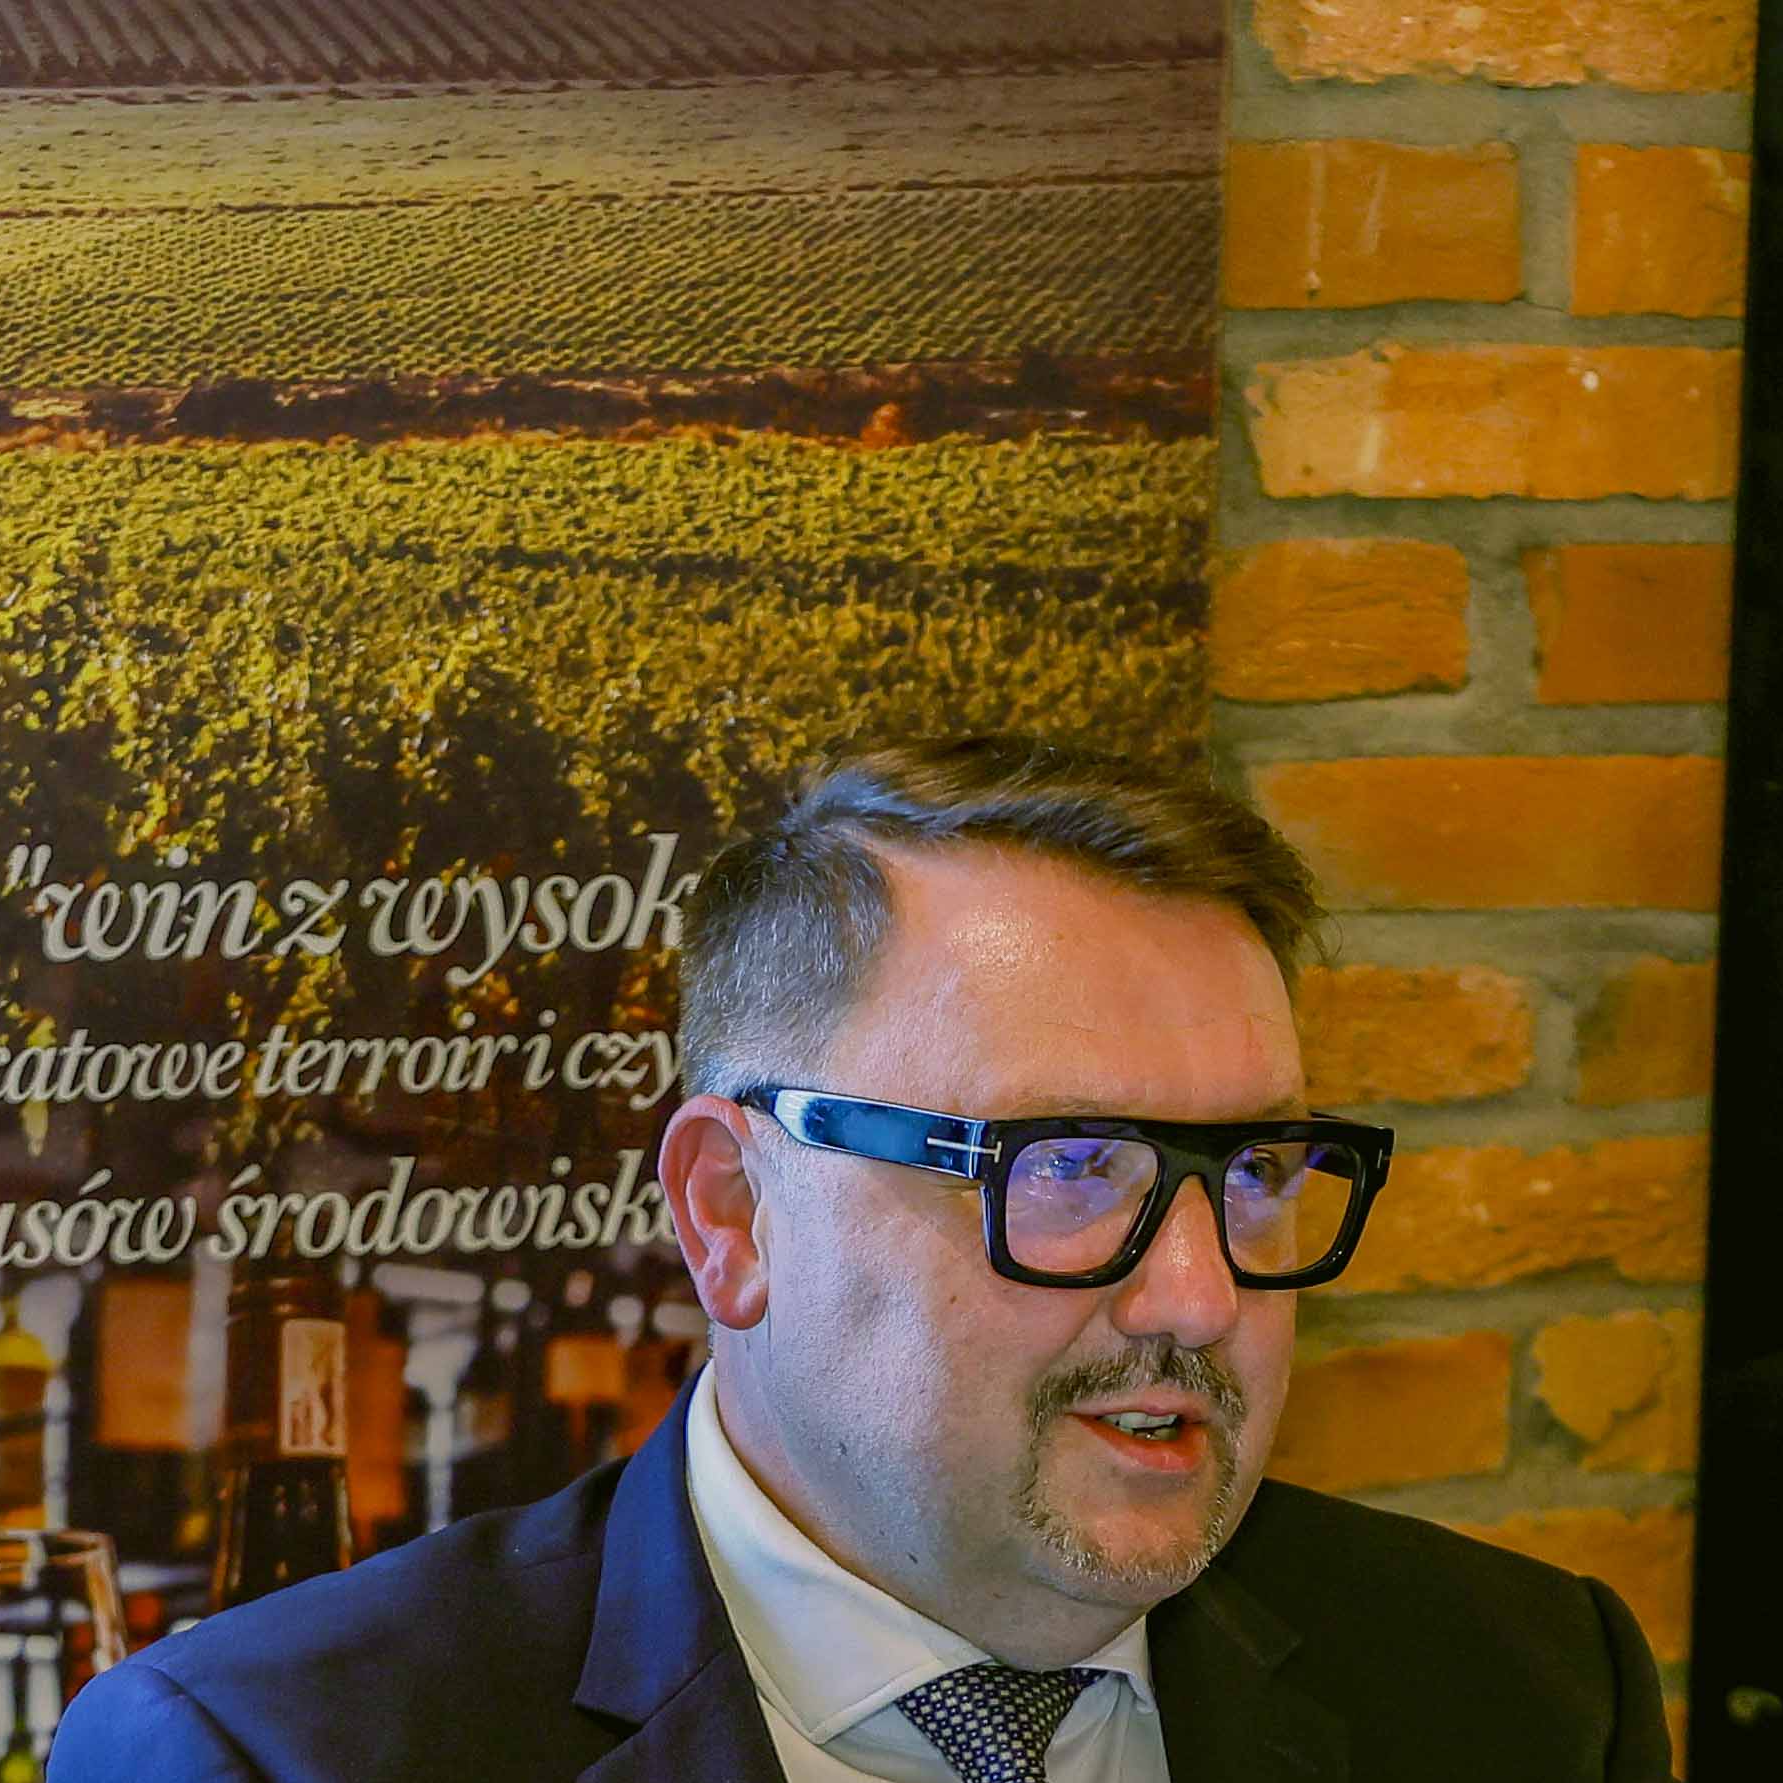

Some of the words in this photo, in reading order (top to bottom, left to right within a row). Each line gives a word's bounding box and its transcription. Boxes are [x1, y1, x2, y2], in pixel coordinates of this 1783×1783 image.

[2, 843, 264, 963] "win
[272, 878, 351, 957] z
[359, 832, 703, 988] wysok
[253, 1010, 518, 1098] terroir
[521, 1008, 557, 1091] i
[562, 1030, 683, 1111] czy
